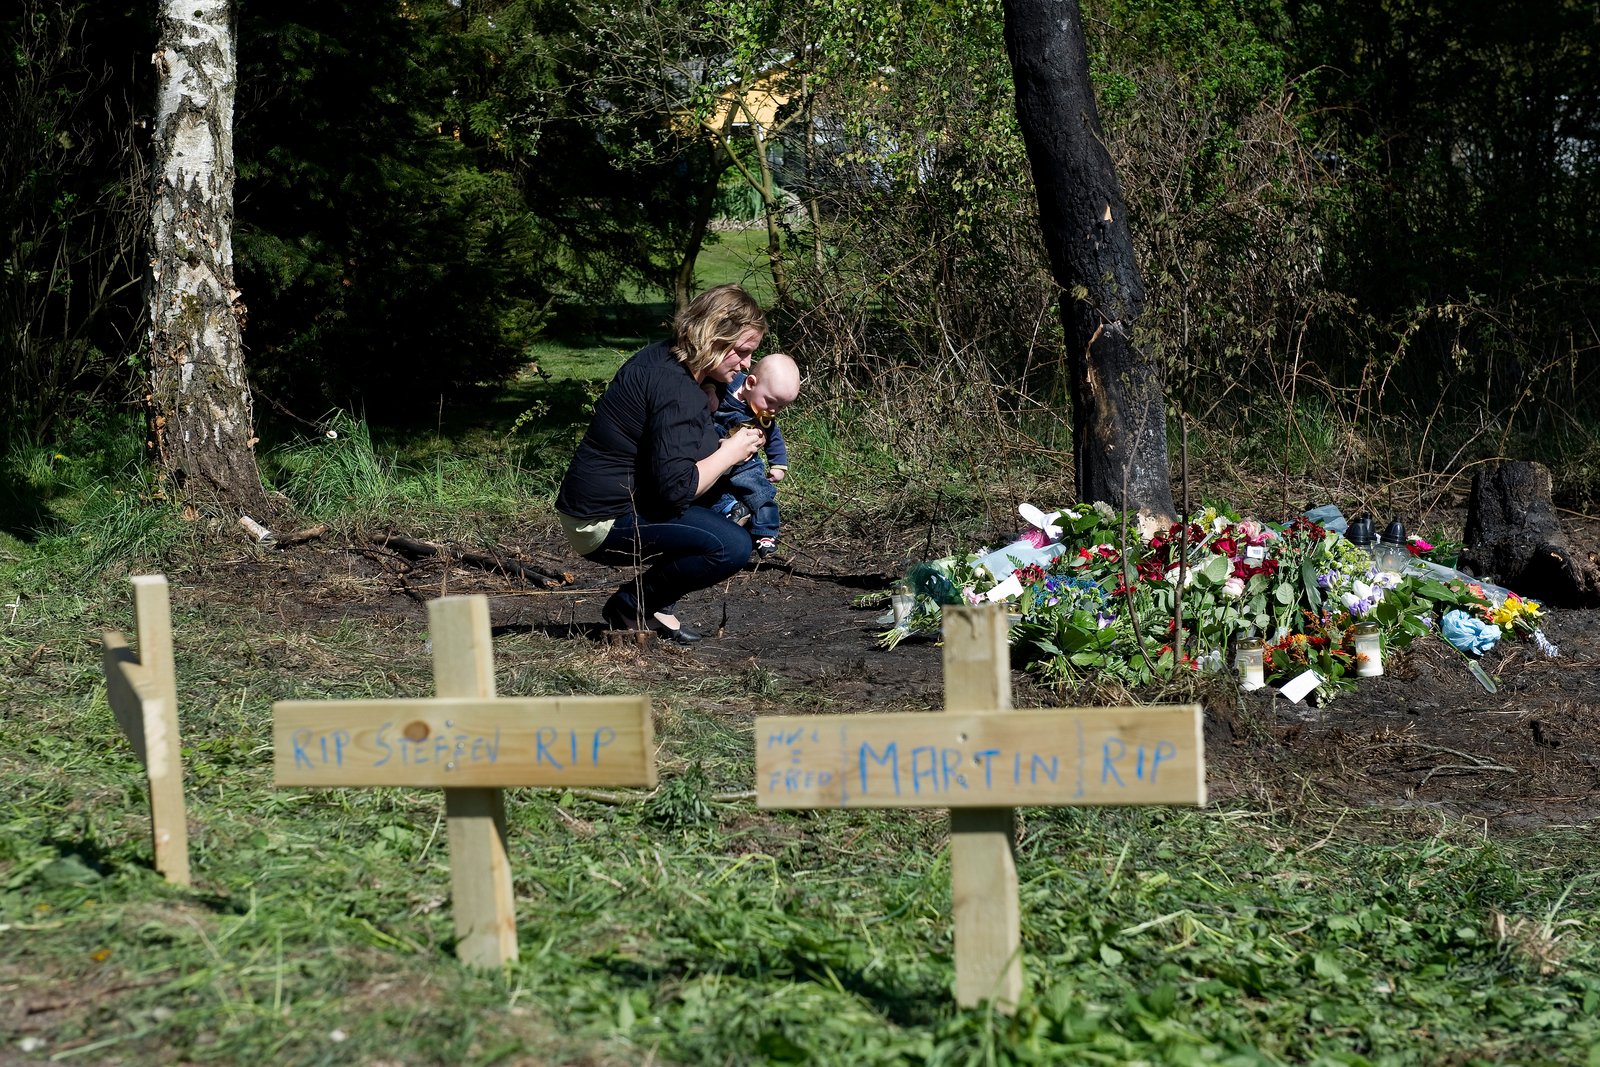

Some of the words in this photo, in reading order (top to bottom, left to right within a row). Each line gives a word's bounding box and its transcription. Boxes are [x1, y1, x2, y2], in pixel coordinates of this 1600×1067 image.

[290, 726, 351, 770] RIP
[534, 724, 618, 772] RIP
[858, 740, 1060, 796] MARTIN
[1100, 736, 1178, 788] RIP
